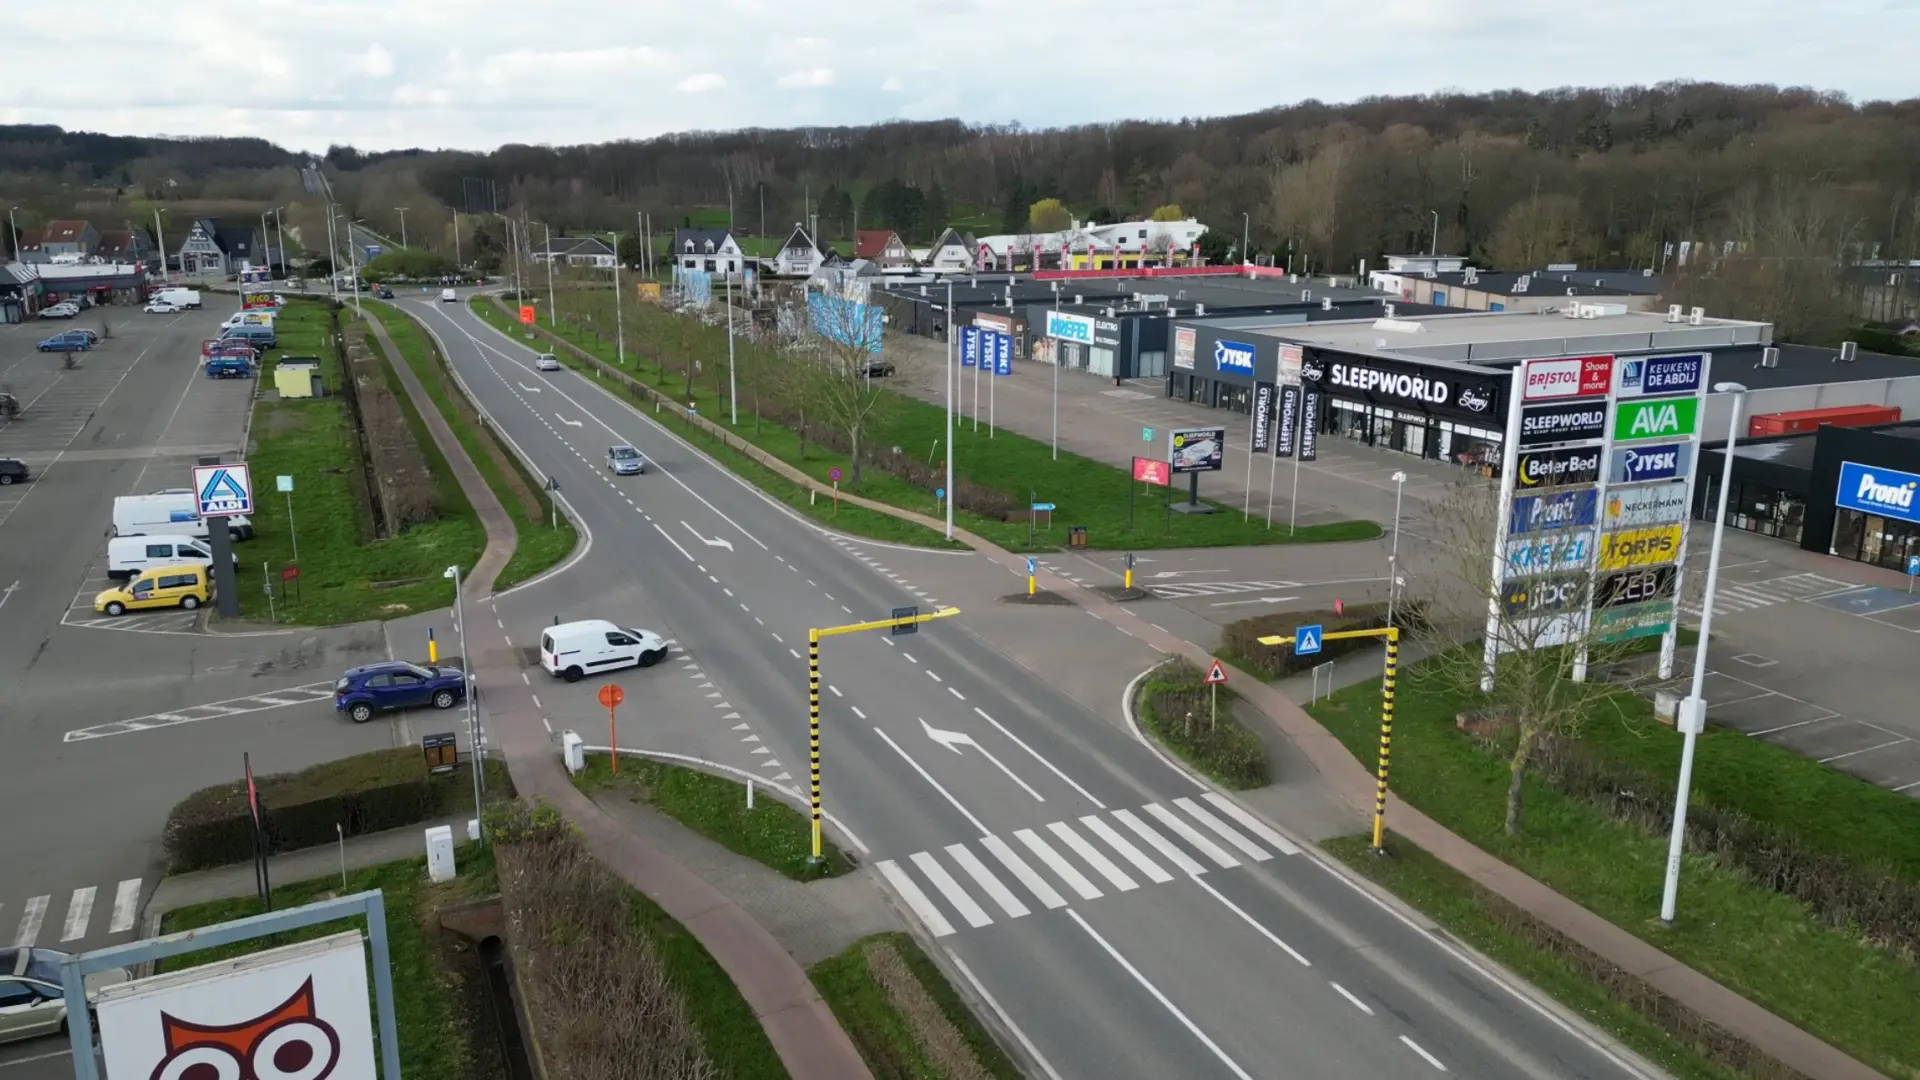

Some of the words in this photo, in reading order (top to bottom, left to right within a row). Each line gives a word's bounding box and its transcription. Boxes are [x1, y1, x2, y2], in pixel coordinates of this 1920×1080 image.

[1222, 348, 1252, 368] JYSK
[1586, 361, 1609, 372] Shoes
[1650, 361, 1697, 375] KEUKENS
[1331, 363, 1449, 404] SLEEPWORLD
[1583, 380, 1607, 390] more!
[1592, 372, 1599, 381] &
[1648, 374, 1662, 387] DE
[1663, 371, 1696, 386] ABDIJ
[1256, 387, 1268, 449] SLEEPWORLD
[1280, 390, 1294, 452] SLEEPWORLD
[1303, 393, 1315, 457] SLEEPWORLD
[1523, 411, 1603, 430] SLEEPWORLD
[1630, 404, 1678, 435] AVA
[1569, 454, 1598, 472] Bed
[1634, 452, 1677, 473] JYSK
[1857, 473, 1918, 508] Pronti
[206, 501, 243, 512] ALDI
[1624, 498, 1684, 512] NECKERMANN
[1512, 540, 1586, 568] KREEL
[1612, 572, 1658, 601] ZEB
